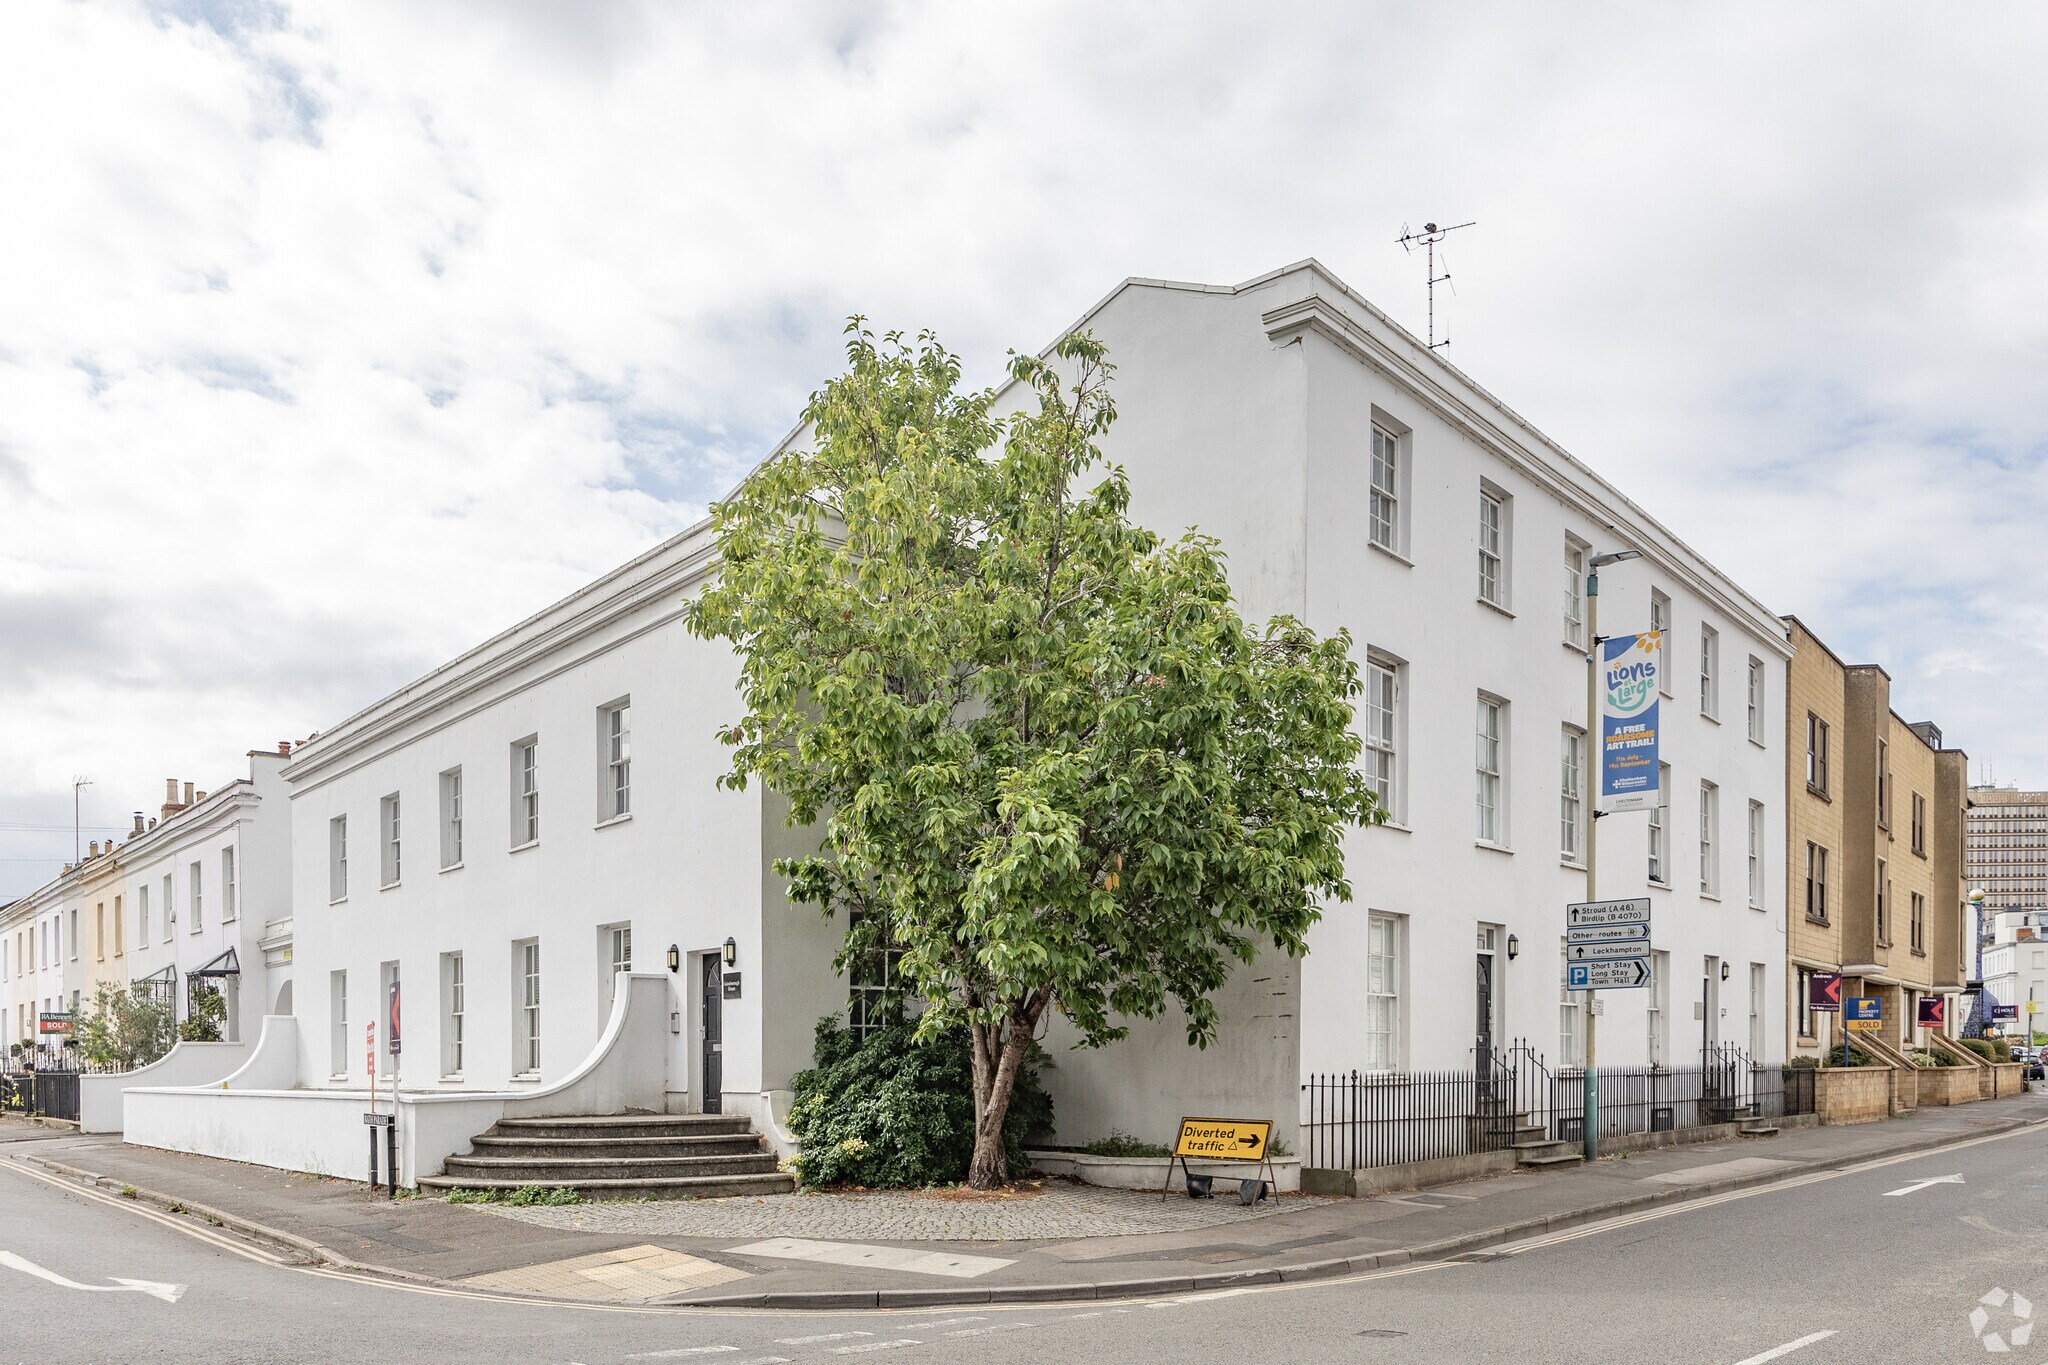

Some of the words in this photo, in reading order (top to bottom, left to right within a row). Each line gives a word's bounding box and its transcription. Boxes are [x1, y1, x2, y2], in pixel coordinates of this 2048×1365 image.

[1607, 662, 1656, 691] Lions
[1618, 678, 1655, 706] Large
[1614, 726, 1622, 735] A
[1623, 724, 1646, 734] FREE
[1606, 730, 1655, 743] ROARSOME
[1606, 742, 1624, 751] ART
[1626, 738, 1654, 748] TRAIL!
[1582, 906, 1606, 914] Stroud
[1593, 946, 1642, 954] Leckhampton
[1574, 969, 1585, 983] P
[1184, 1126, 1235, 1138] Diverted
[1188, 1140, 1224, 1151] traffic
